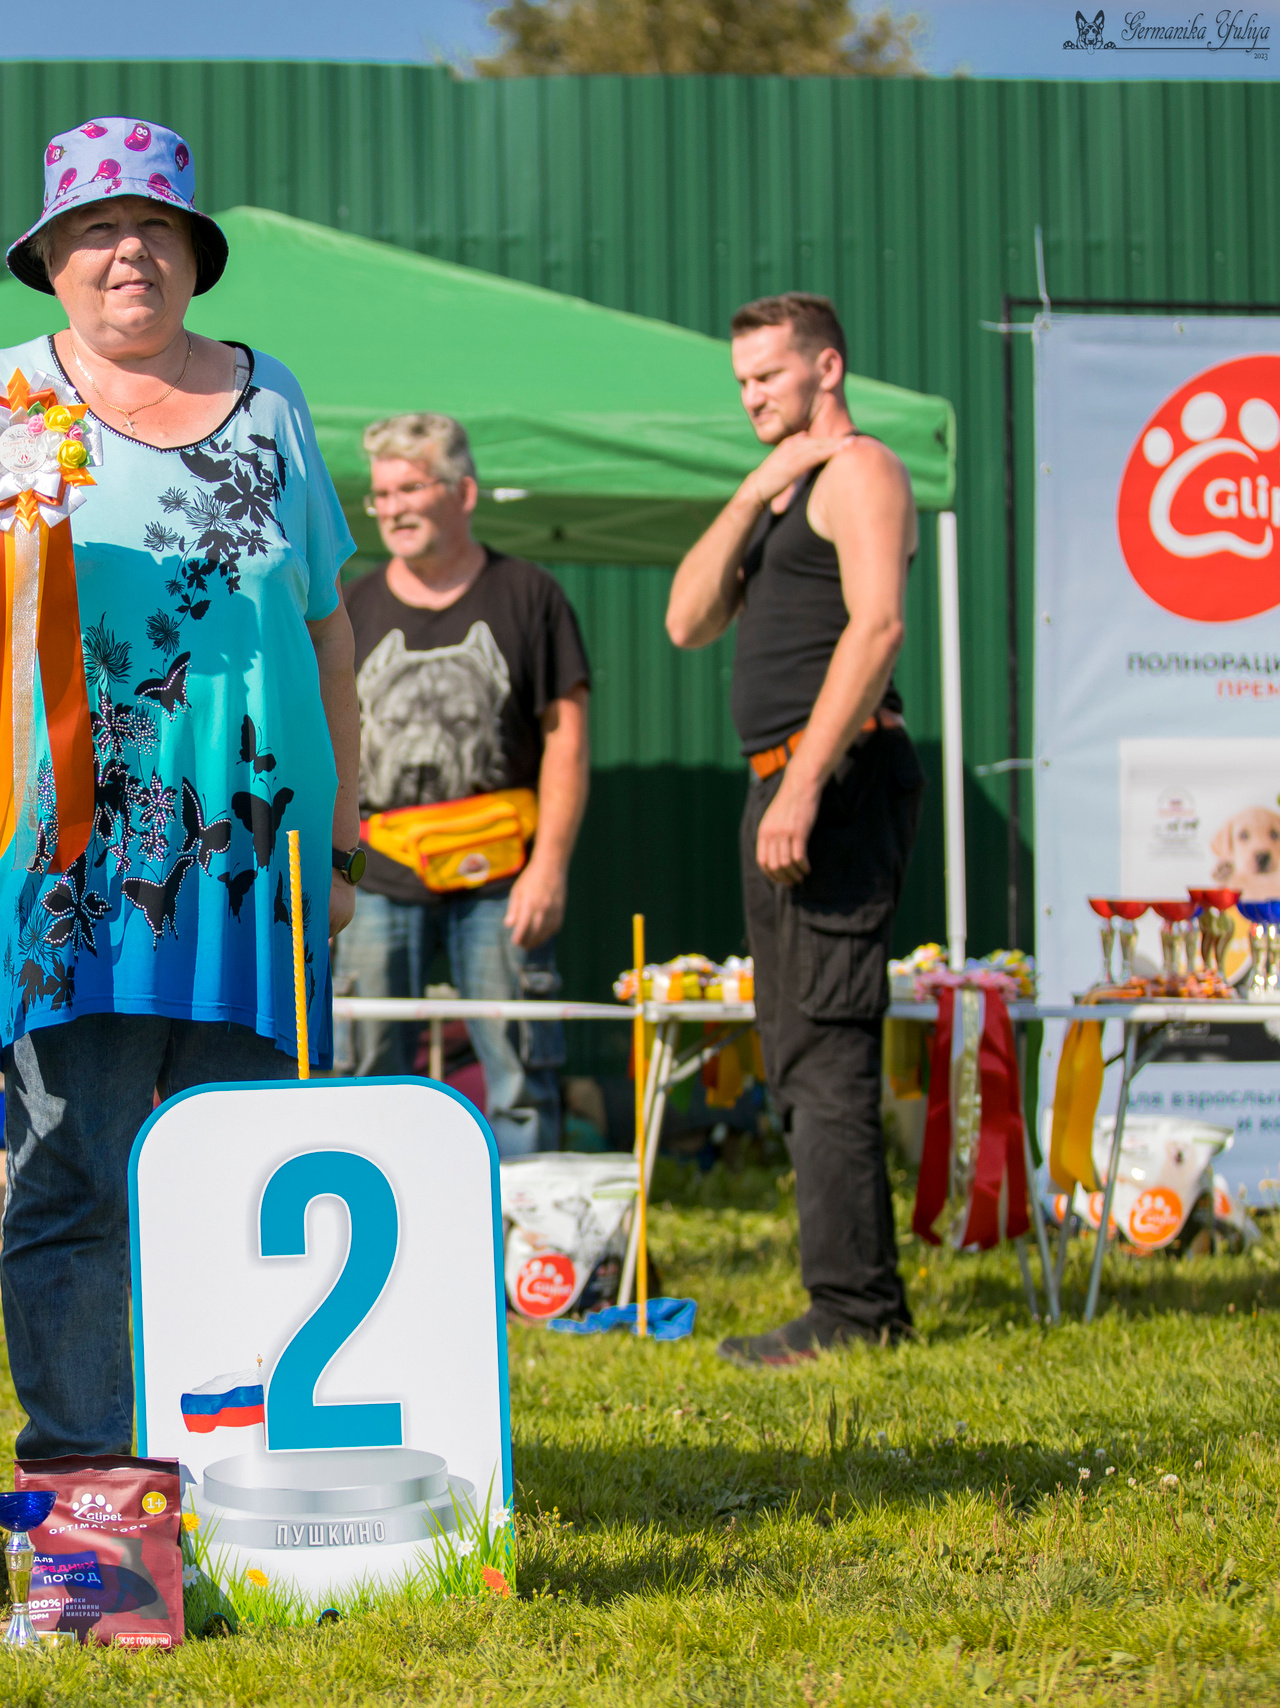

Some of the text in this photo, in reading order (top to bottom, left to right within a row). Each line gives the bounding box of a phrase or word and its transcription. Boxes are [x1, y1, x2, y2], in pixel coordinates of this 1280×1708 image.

[1172, 1091, 1280, 1112] взрослы
[260, 1150, 403, 1451] 2
[146, 1497, 164, 1509] 1+
[86, 1512, 122, 1522] Glipet
[276, 1520, 386, 1546] ПУШКИНО
[32, 1561, 96, 1575] СРЕДНИХ
[43, 1572, 101, 1584] ПОРОД
[28, 1598, 61, 1610] 100%
